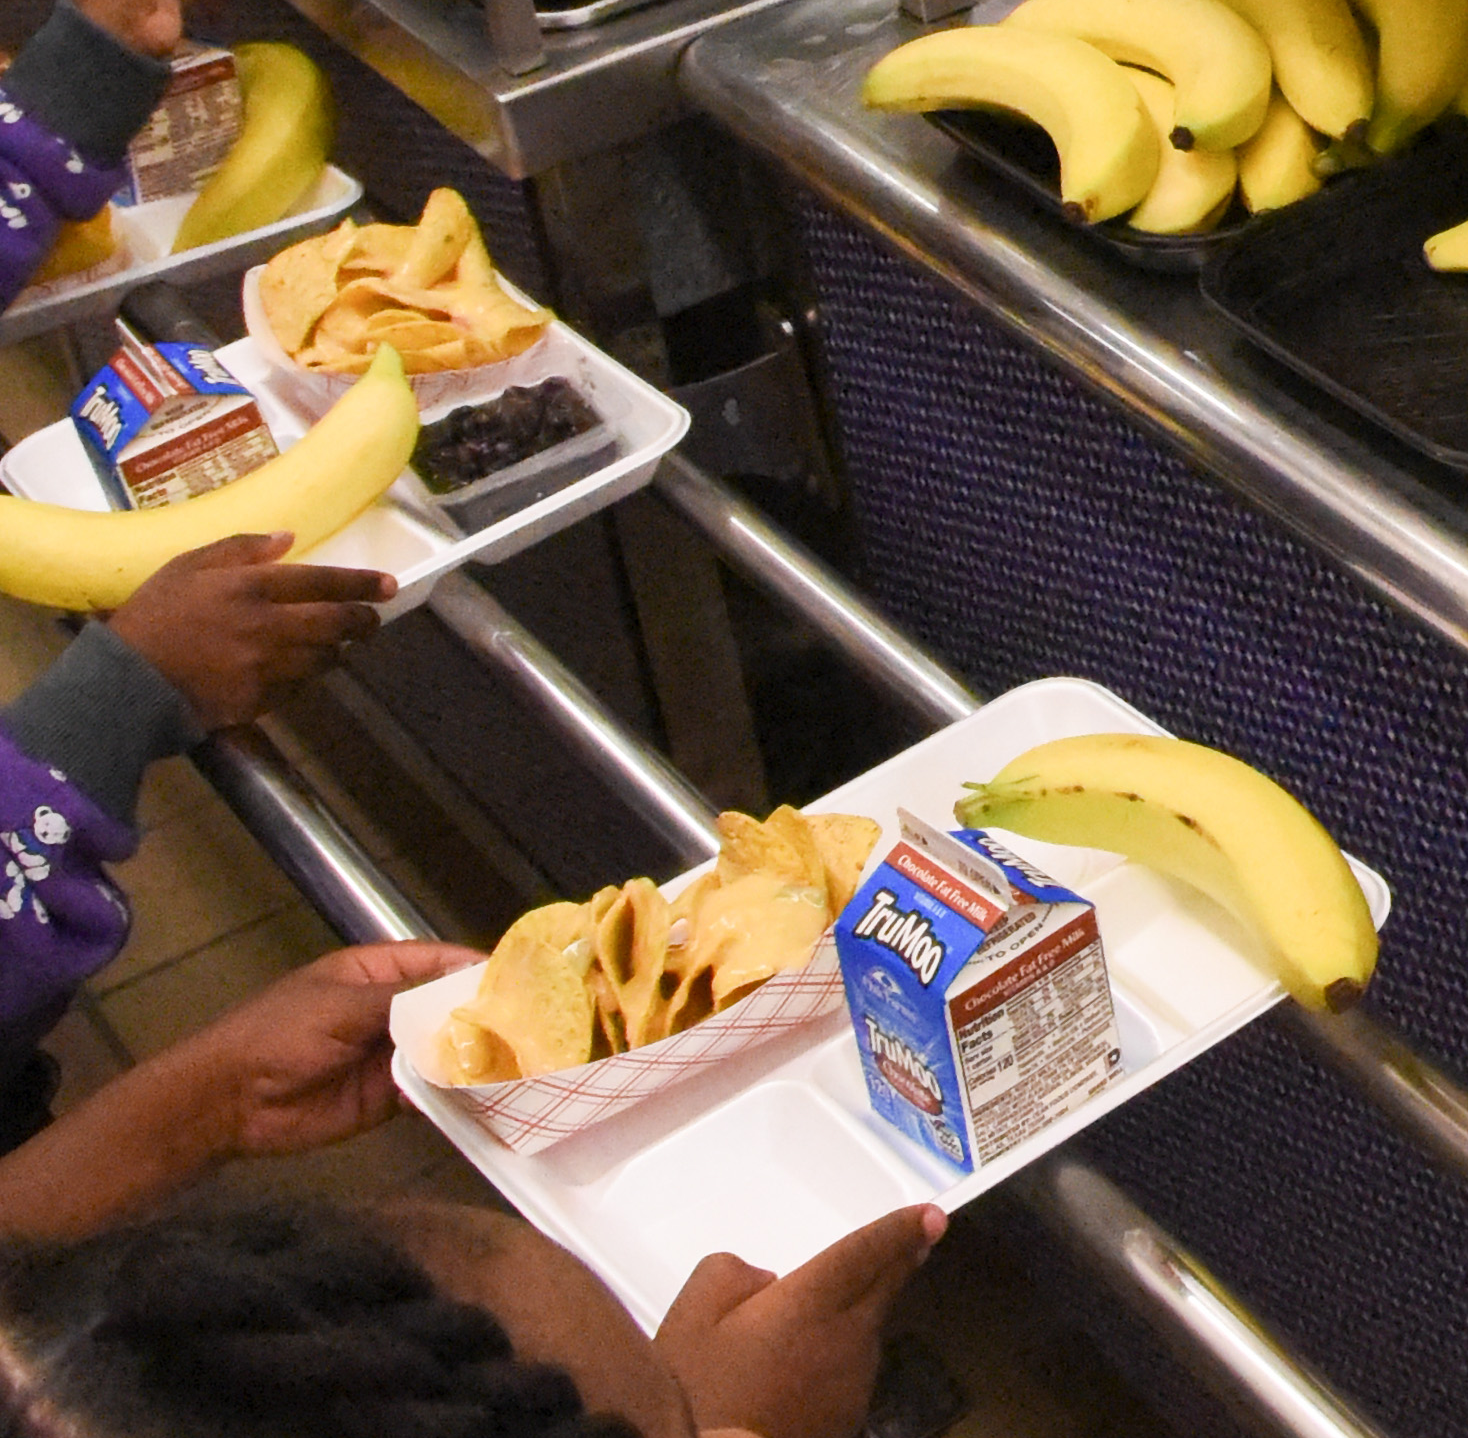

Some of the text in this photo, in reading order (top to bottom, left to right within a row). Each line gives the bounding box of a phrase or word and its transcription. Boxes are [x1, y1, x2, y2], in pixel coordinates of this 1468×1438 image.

[897, 854, 938, 887] Chocolate
[935, 880, 951, 897] Fat
[948, 889, 970, 908] Free
[967, 900, 989, 922] Milk
[855, 891, 943, 985] TruMoo
[987, 923, 1044, 961] TO OPEN
[965, 928, 1086, 1011] Chocolate Fat Free Milk
[959, 1009, 1005, 1040] Nutrition
[961, 1030, 994, 1054] Facts
[865, 1016, 943, 1102] TruMoo
[997, 1054, 1014, 1073] 120
